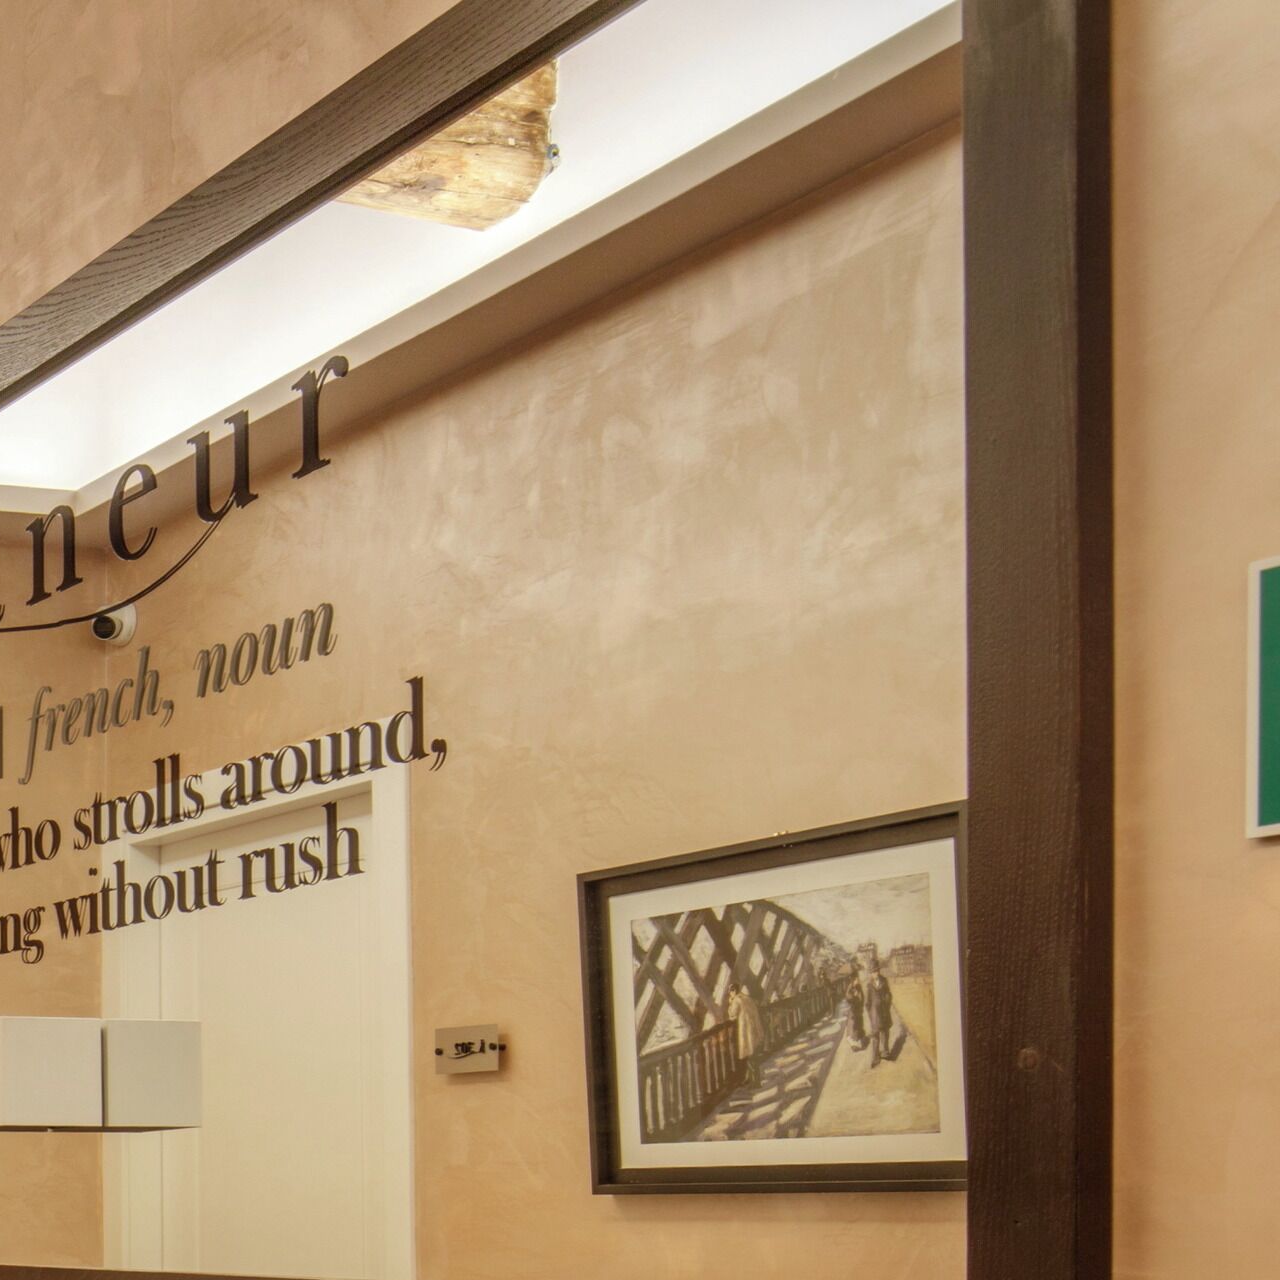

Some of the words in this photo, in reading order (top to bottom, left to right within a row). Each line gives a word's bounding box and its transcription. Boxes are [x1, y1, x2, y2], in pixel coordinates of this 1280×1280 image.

[19, 645, 175, 785] french,
[195, 602, 338, 698] noun
[73, 752, 204, 852] strolls
[220, 676, 448, 811] around,
[54, 849, 228, 941] without
[238, 801, 366, 900] rush
